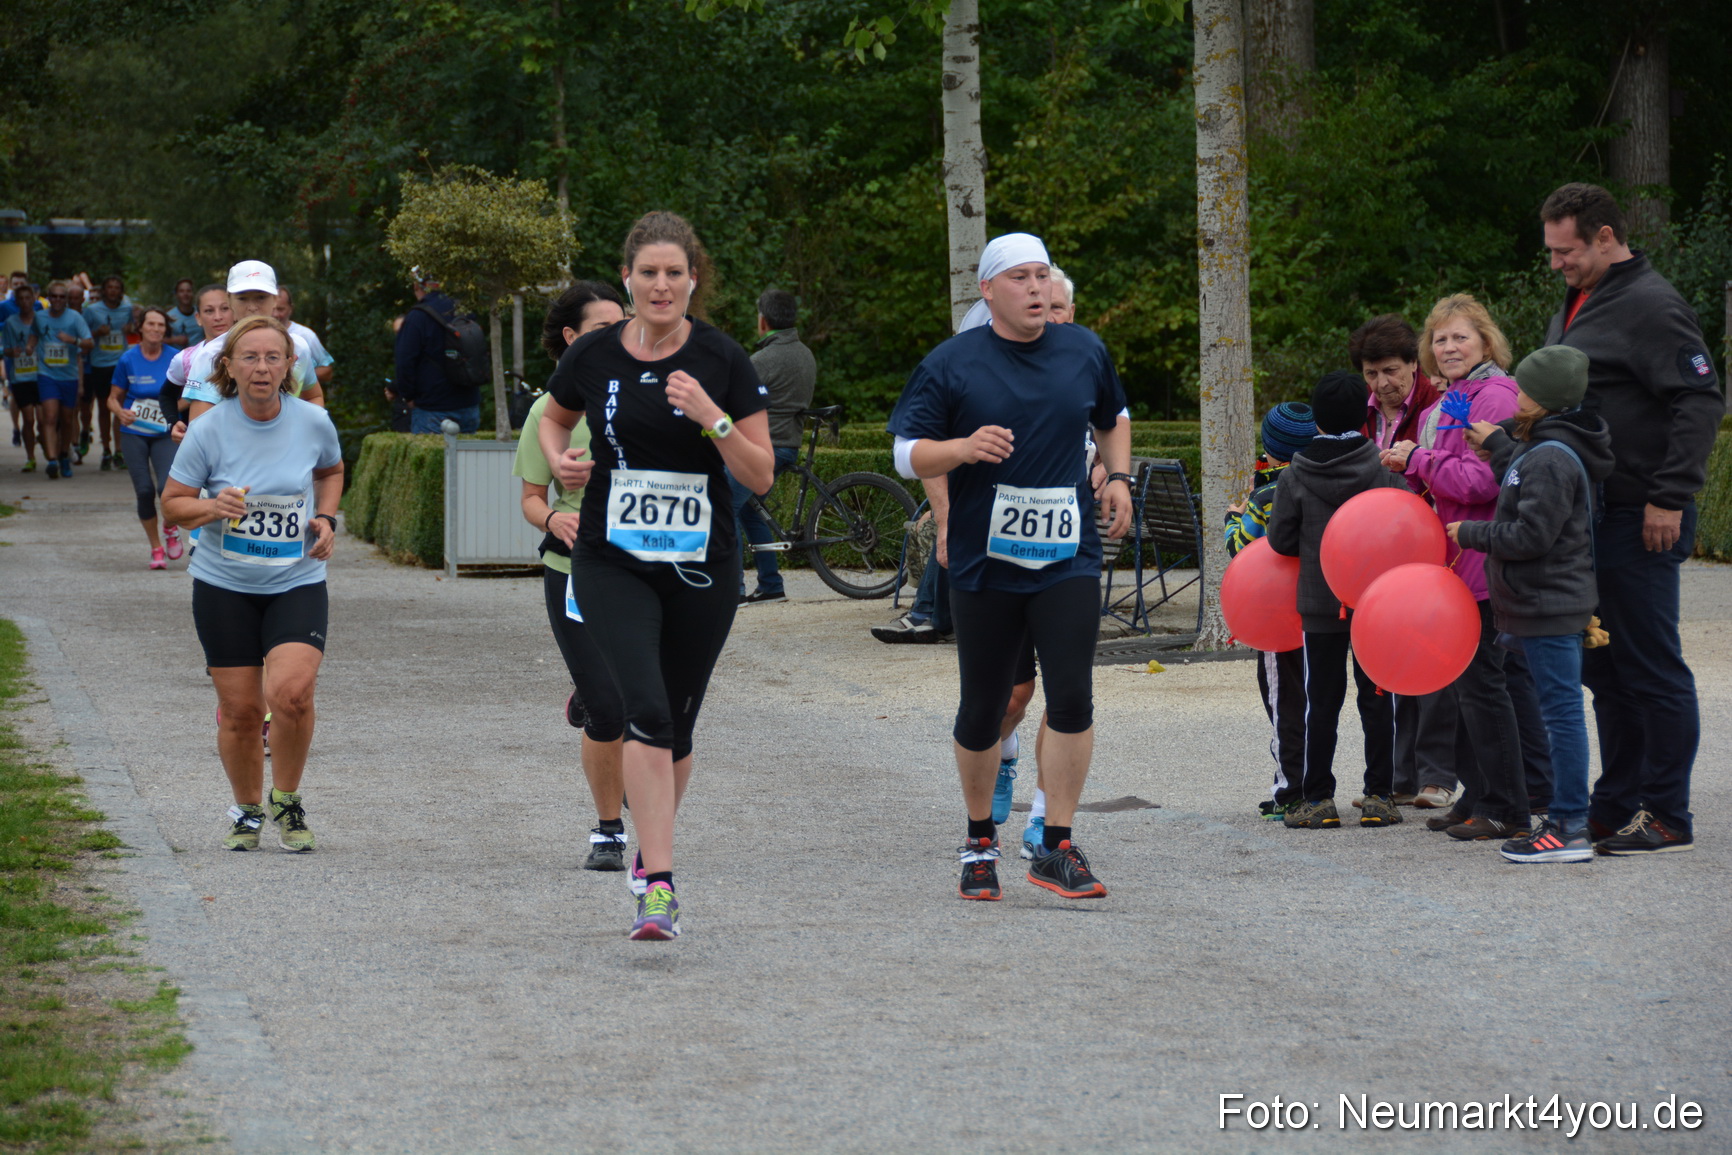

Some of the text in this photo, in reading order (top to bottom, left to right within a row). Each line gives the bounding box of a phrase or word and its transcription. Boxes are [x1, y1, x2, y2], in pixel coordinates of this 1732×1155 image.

[135, 405, 165, 423] 3042
[647, 480, 690, 491] Neumarkt
[257, 501, 295, 510] Neumarkt
[998, 493, 1066, 505] PARTL Neumarkt
[619, 492, 701, 526] 2670
[228, 511, 299, 538] 2338
[1000, 507, 1072, 538] 2618
[642, 534, 675, 550] Katja
[247, 543, 278, 557] Helga
[1010, 543, 1057, 558] Gerhard
